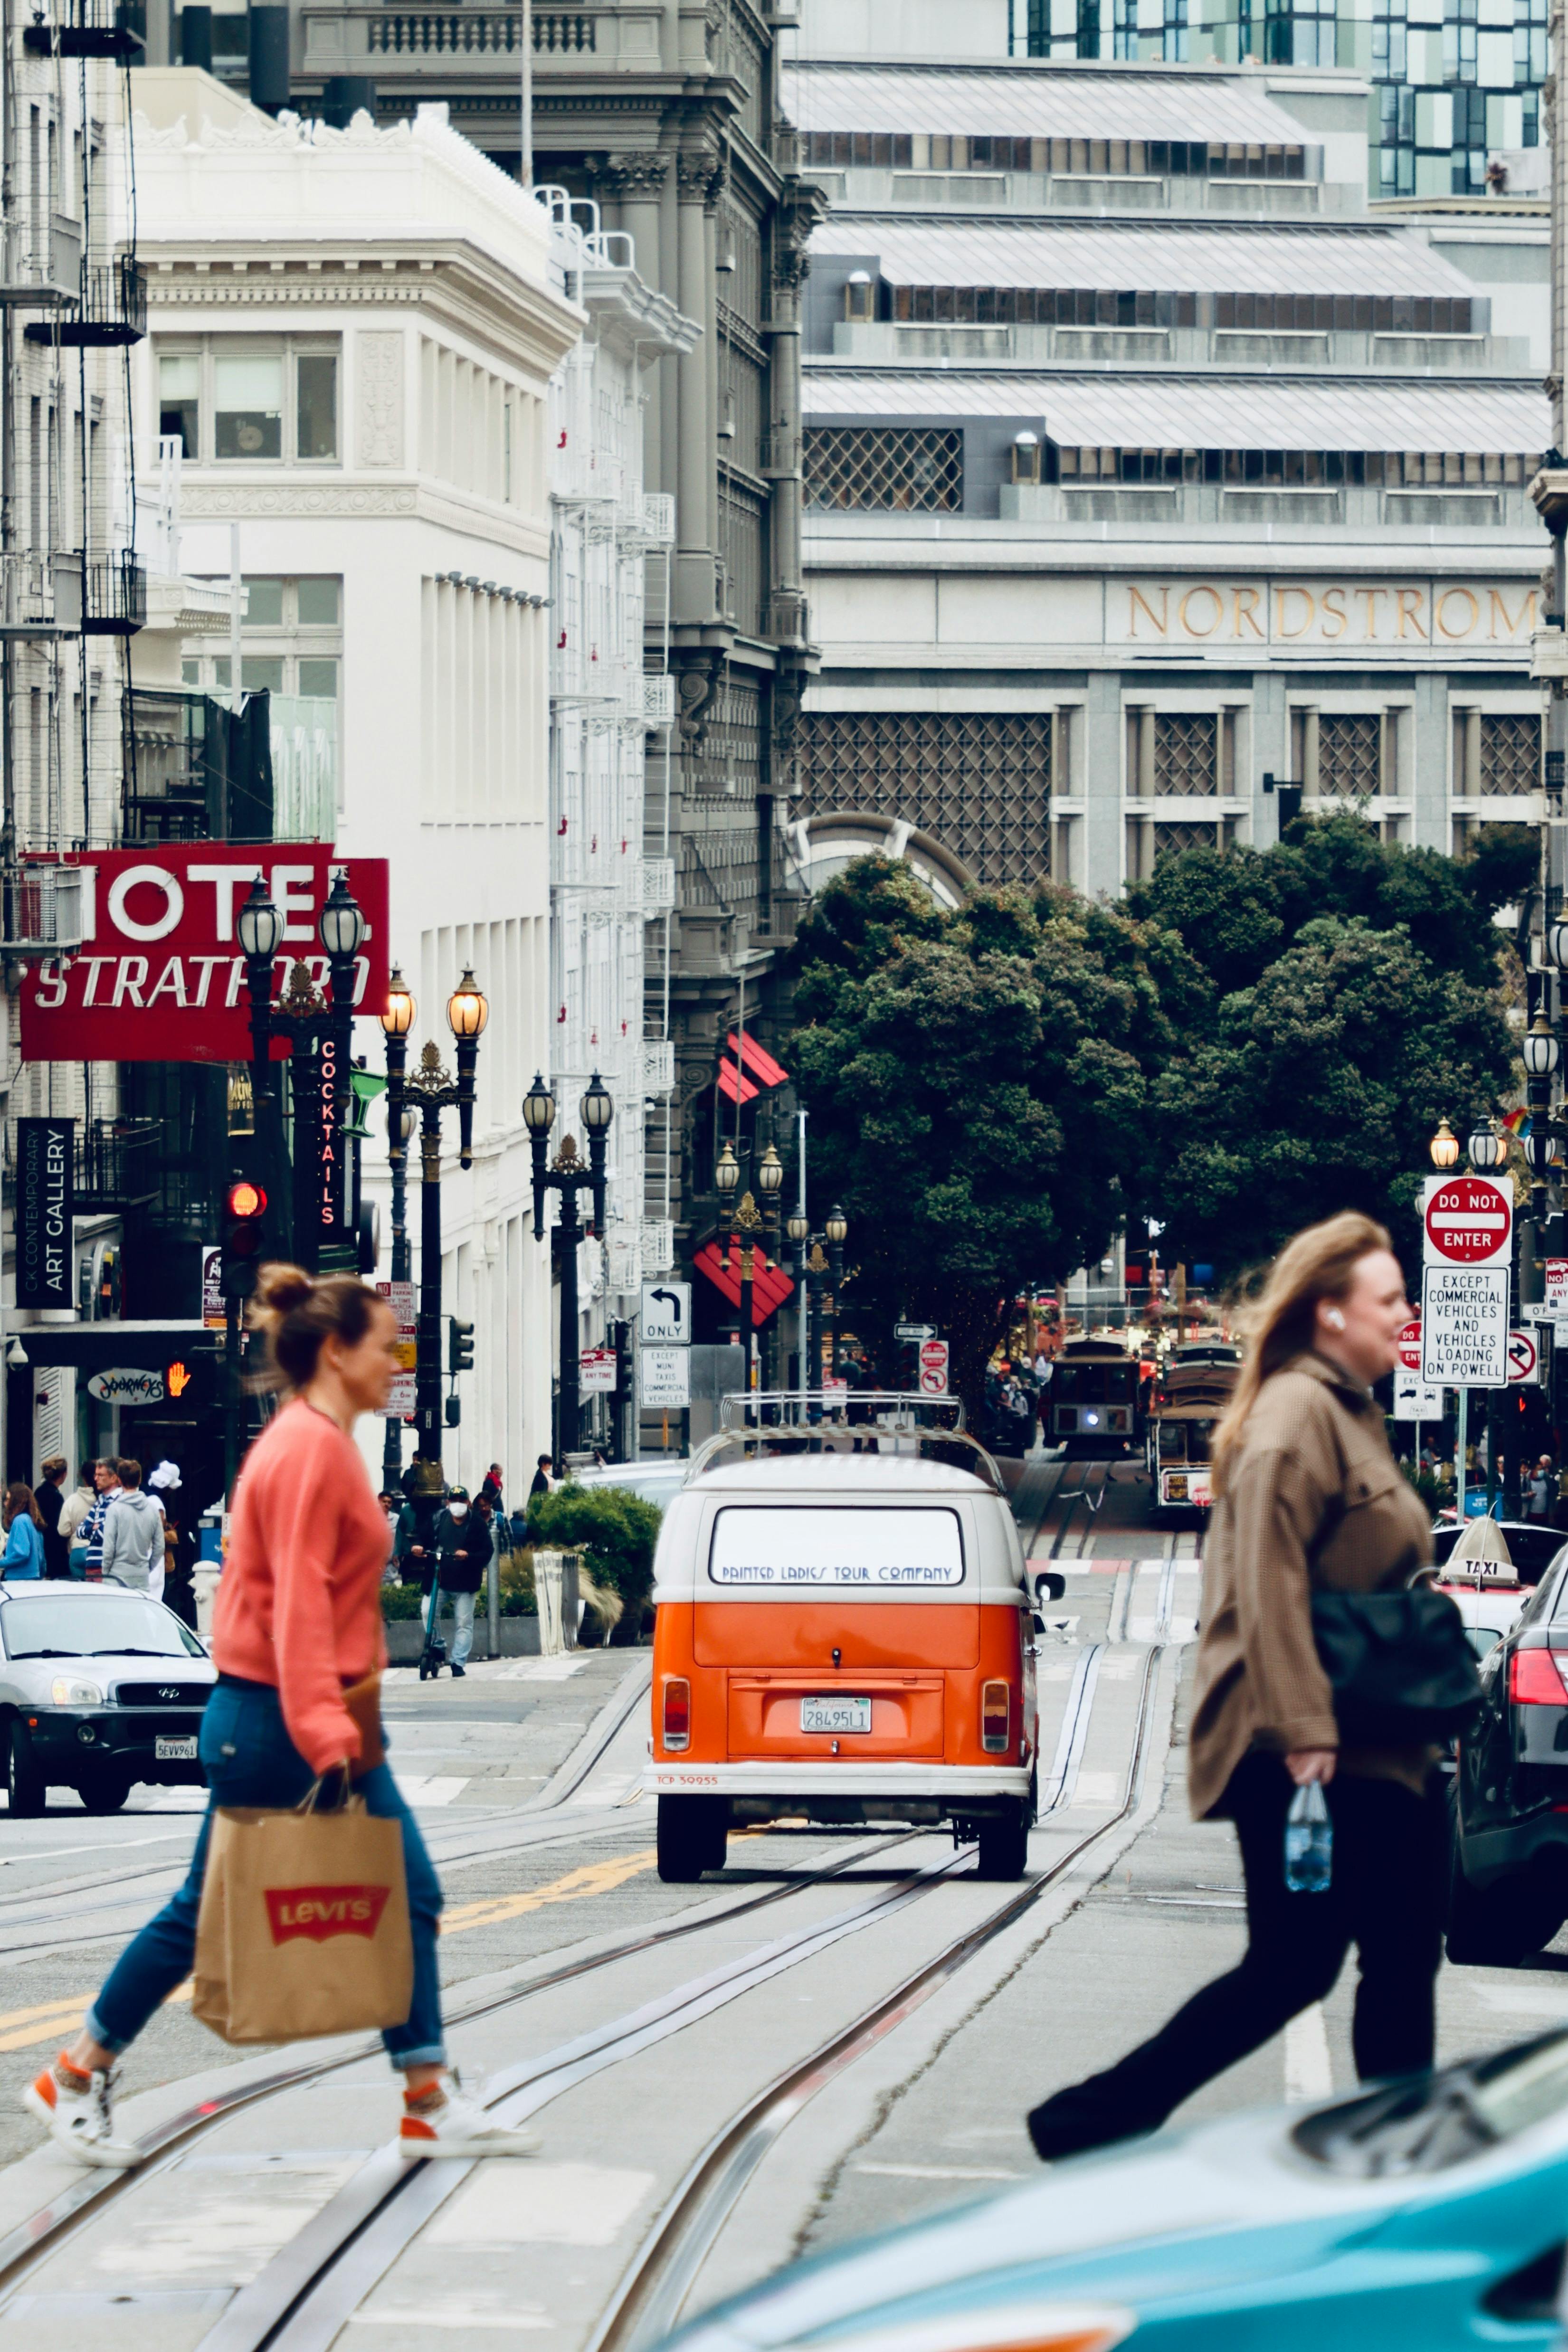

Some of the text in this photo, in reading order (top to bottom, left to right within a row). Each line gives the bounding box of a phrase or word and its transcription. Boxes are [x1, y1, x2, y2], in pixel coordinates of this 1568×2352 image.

[1127, 586, 1539, 639] NORDSTROM
[322, 1041, 336, 1224] COCKTAILS
[1439, 1195, 1498, 1209] DO NOT
[26, 1129, 39, 1292] CK CONTEMPORARY
[46, 1129, 64, 1291] ART GALLERY
[1444, 1233, 1492, 1247] ENTER
[1443, 1276, 1491, 1288] EXCEPT
[1429, 1290, 1503, 1304] COMMERCIAL
[1552, 1289, 1568, 1297] ANY
[1436, 1305, 1497, 1318] VEHICLES
[647, 1326, 682, 1337] ONLY
[1454, 1320, 1479, 1332] AND
[1403, 1331, 1415, 1340] DO
[1435, 1334, 1496, 1347] VEHICLES
[651, 1352, 678, 1360] EXCEPT
[1405, 1353, 1420, 1361] ENT
[1438, 1348, 1492, 1362] LOADING
[1427, 1363, 1501, 1376] ON POWELL
[99, 1374, 163, 1399] JOURNEYS
[648, 1394, 684, 1403] VEHICLES
[722, 1566, 953, 1581] PAINTED LADIES TOUR COMPANY
[1466, 1560, 1498, 1575] TAXI
[159, 1745, 194, 1756] 5EVV961
[657, 1776, 675, 1785] TCP
